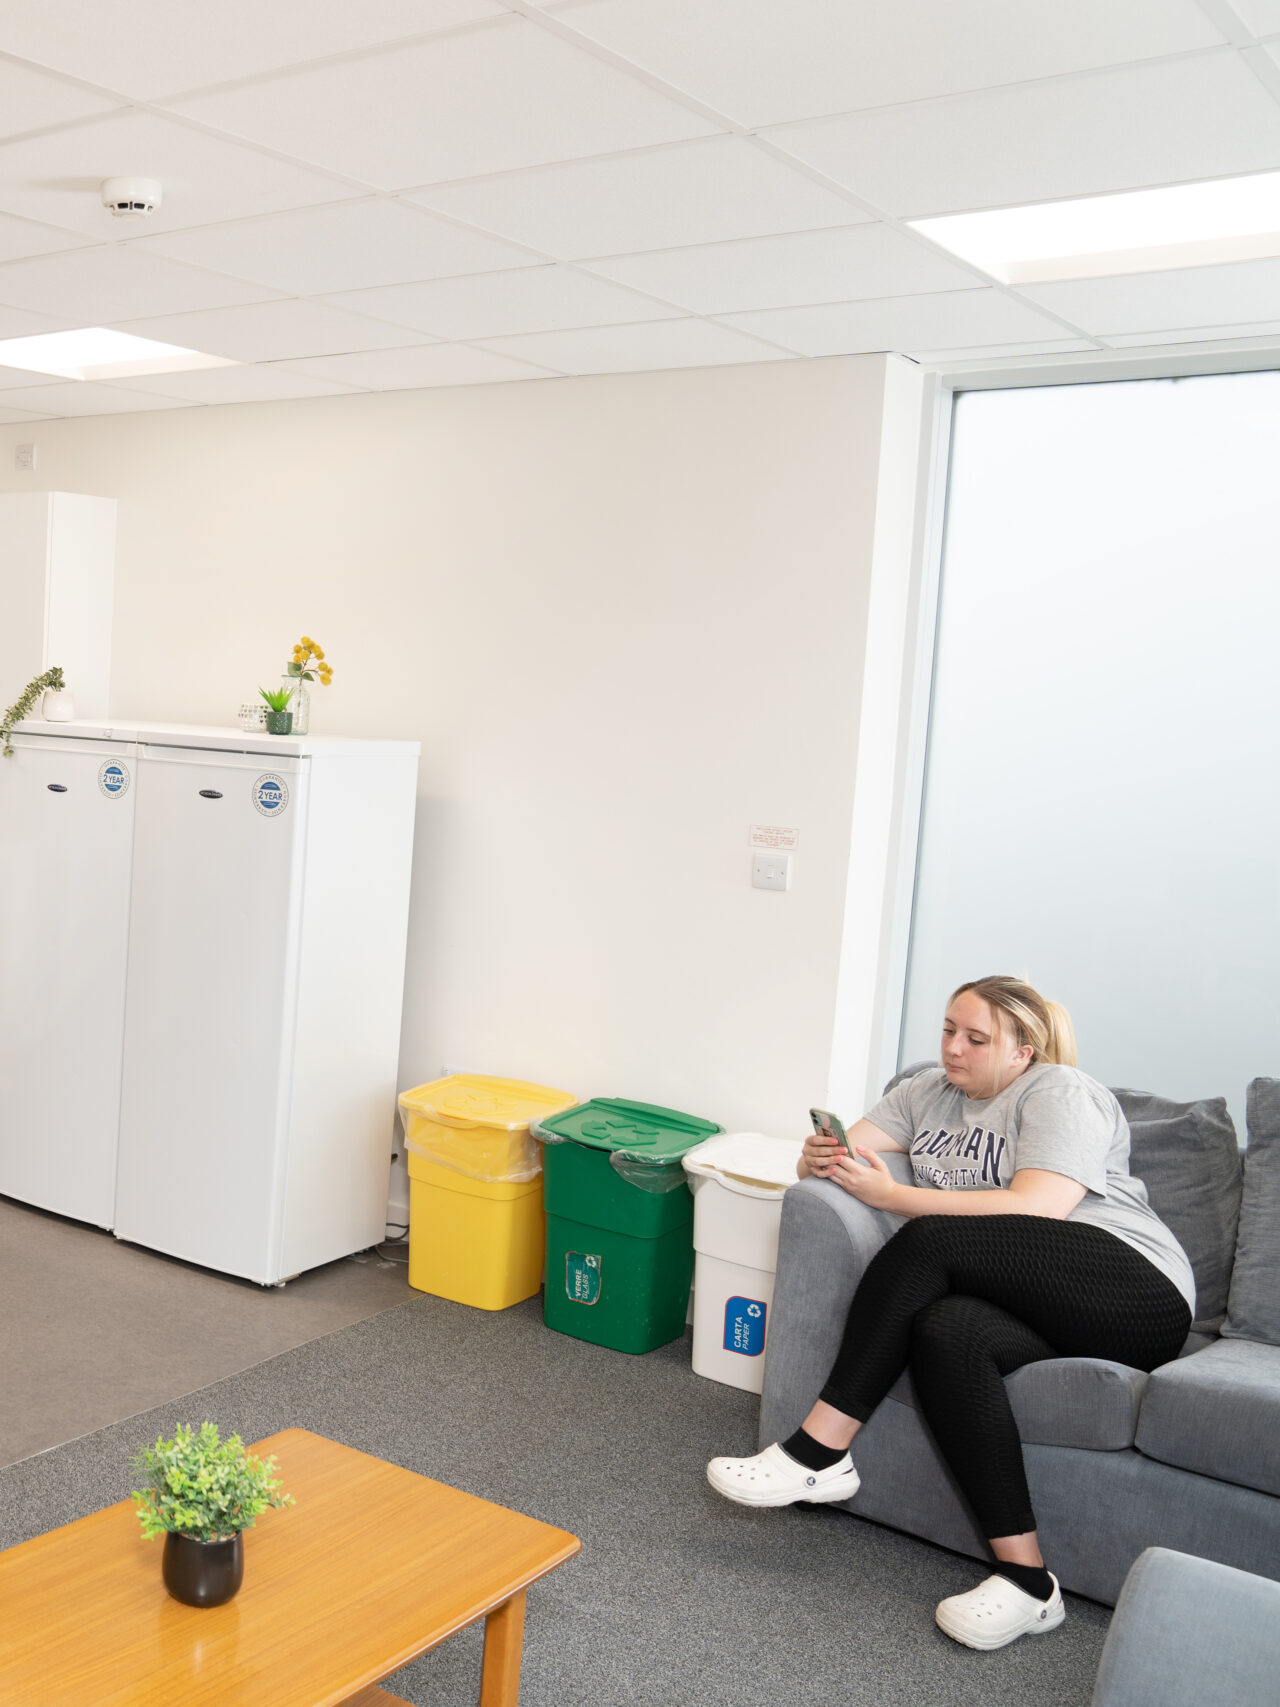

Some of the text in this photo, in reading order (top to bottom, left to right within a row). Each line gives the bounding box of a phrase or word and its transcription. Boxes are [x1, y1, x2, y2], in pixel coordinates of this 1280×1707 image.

[103, 774, 125, 785] 2 YEAR
[258, 790, 283, 801] 2 YEAR
[914, 1164, 978, 1186] NIVERITY
[582, 1273, 590, 1299] GLASS
[733, 1316, 743, 1348] CARTA
[742, 1323, 750, 1350] PAPER
